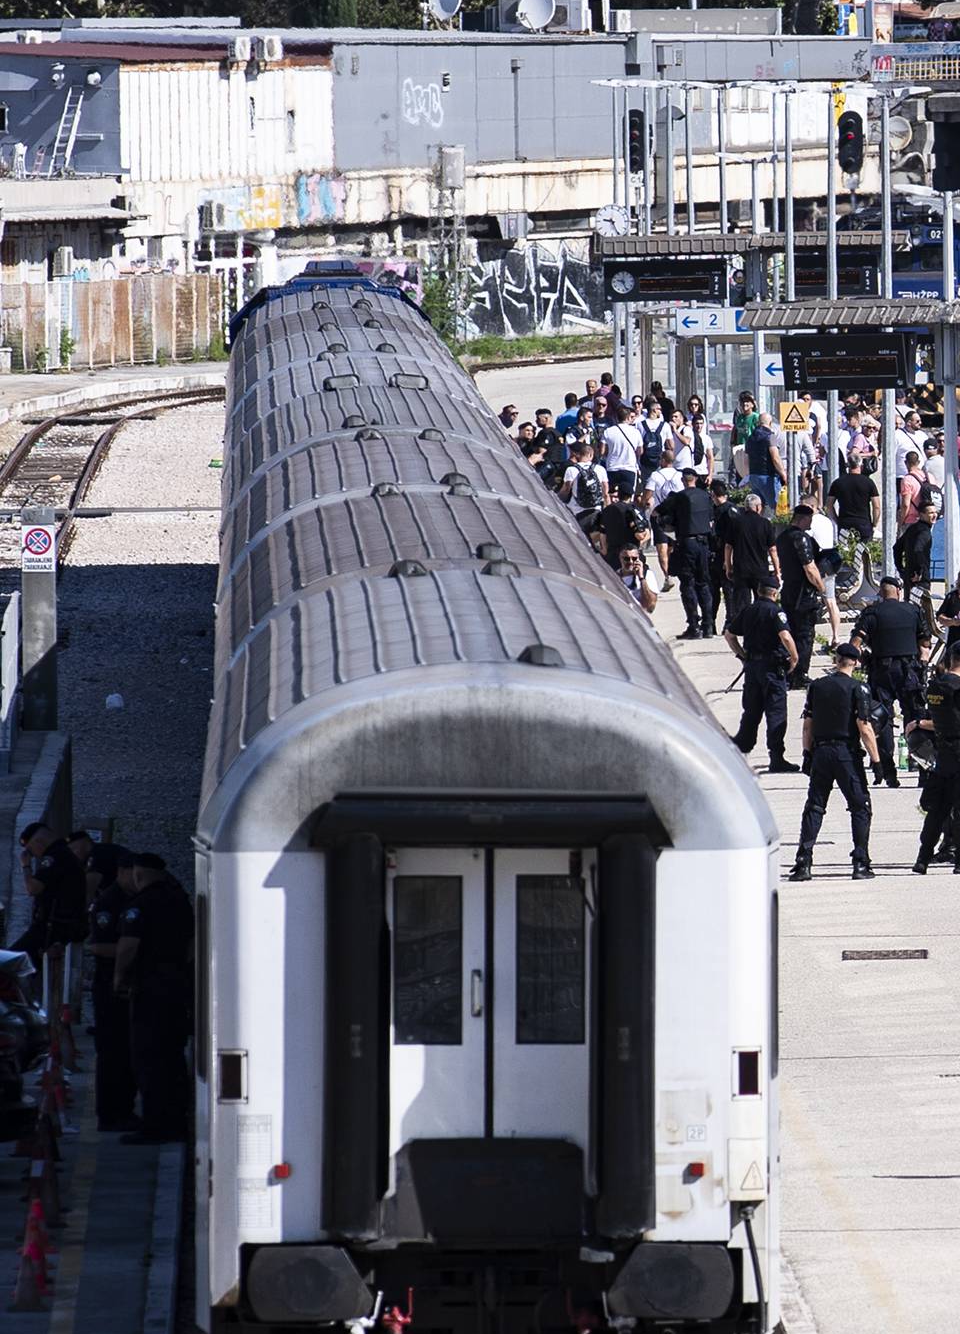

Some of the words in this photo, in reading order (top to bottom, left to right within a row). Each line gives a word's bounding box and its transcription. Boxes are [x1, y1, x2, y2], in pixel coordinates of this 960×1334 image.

[930, 230, 944, 238] 02
[912, 289, 939, 299] HŽPP
[709, 313, 718, 326] 2
[793, 358, 799, 367] 2
[794, 369, 800, 378] 2
[689, 1128, 704, 1140] 2P
